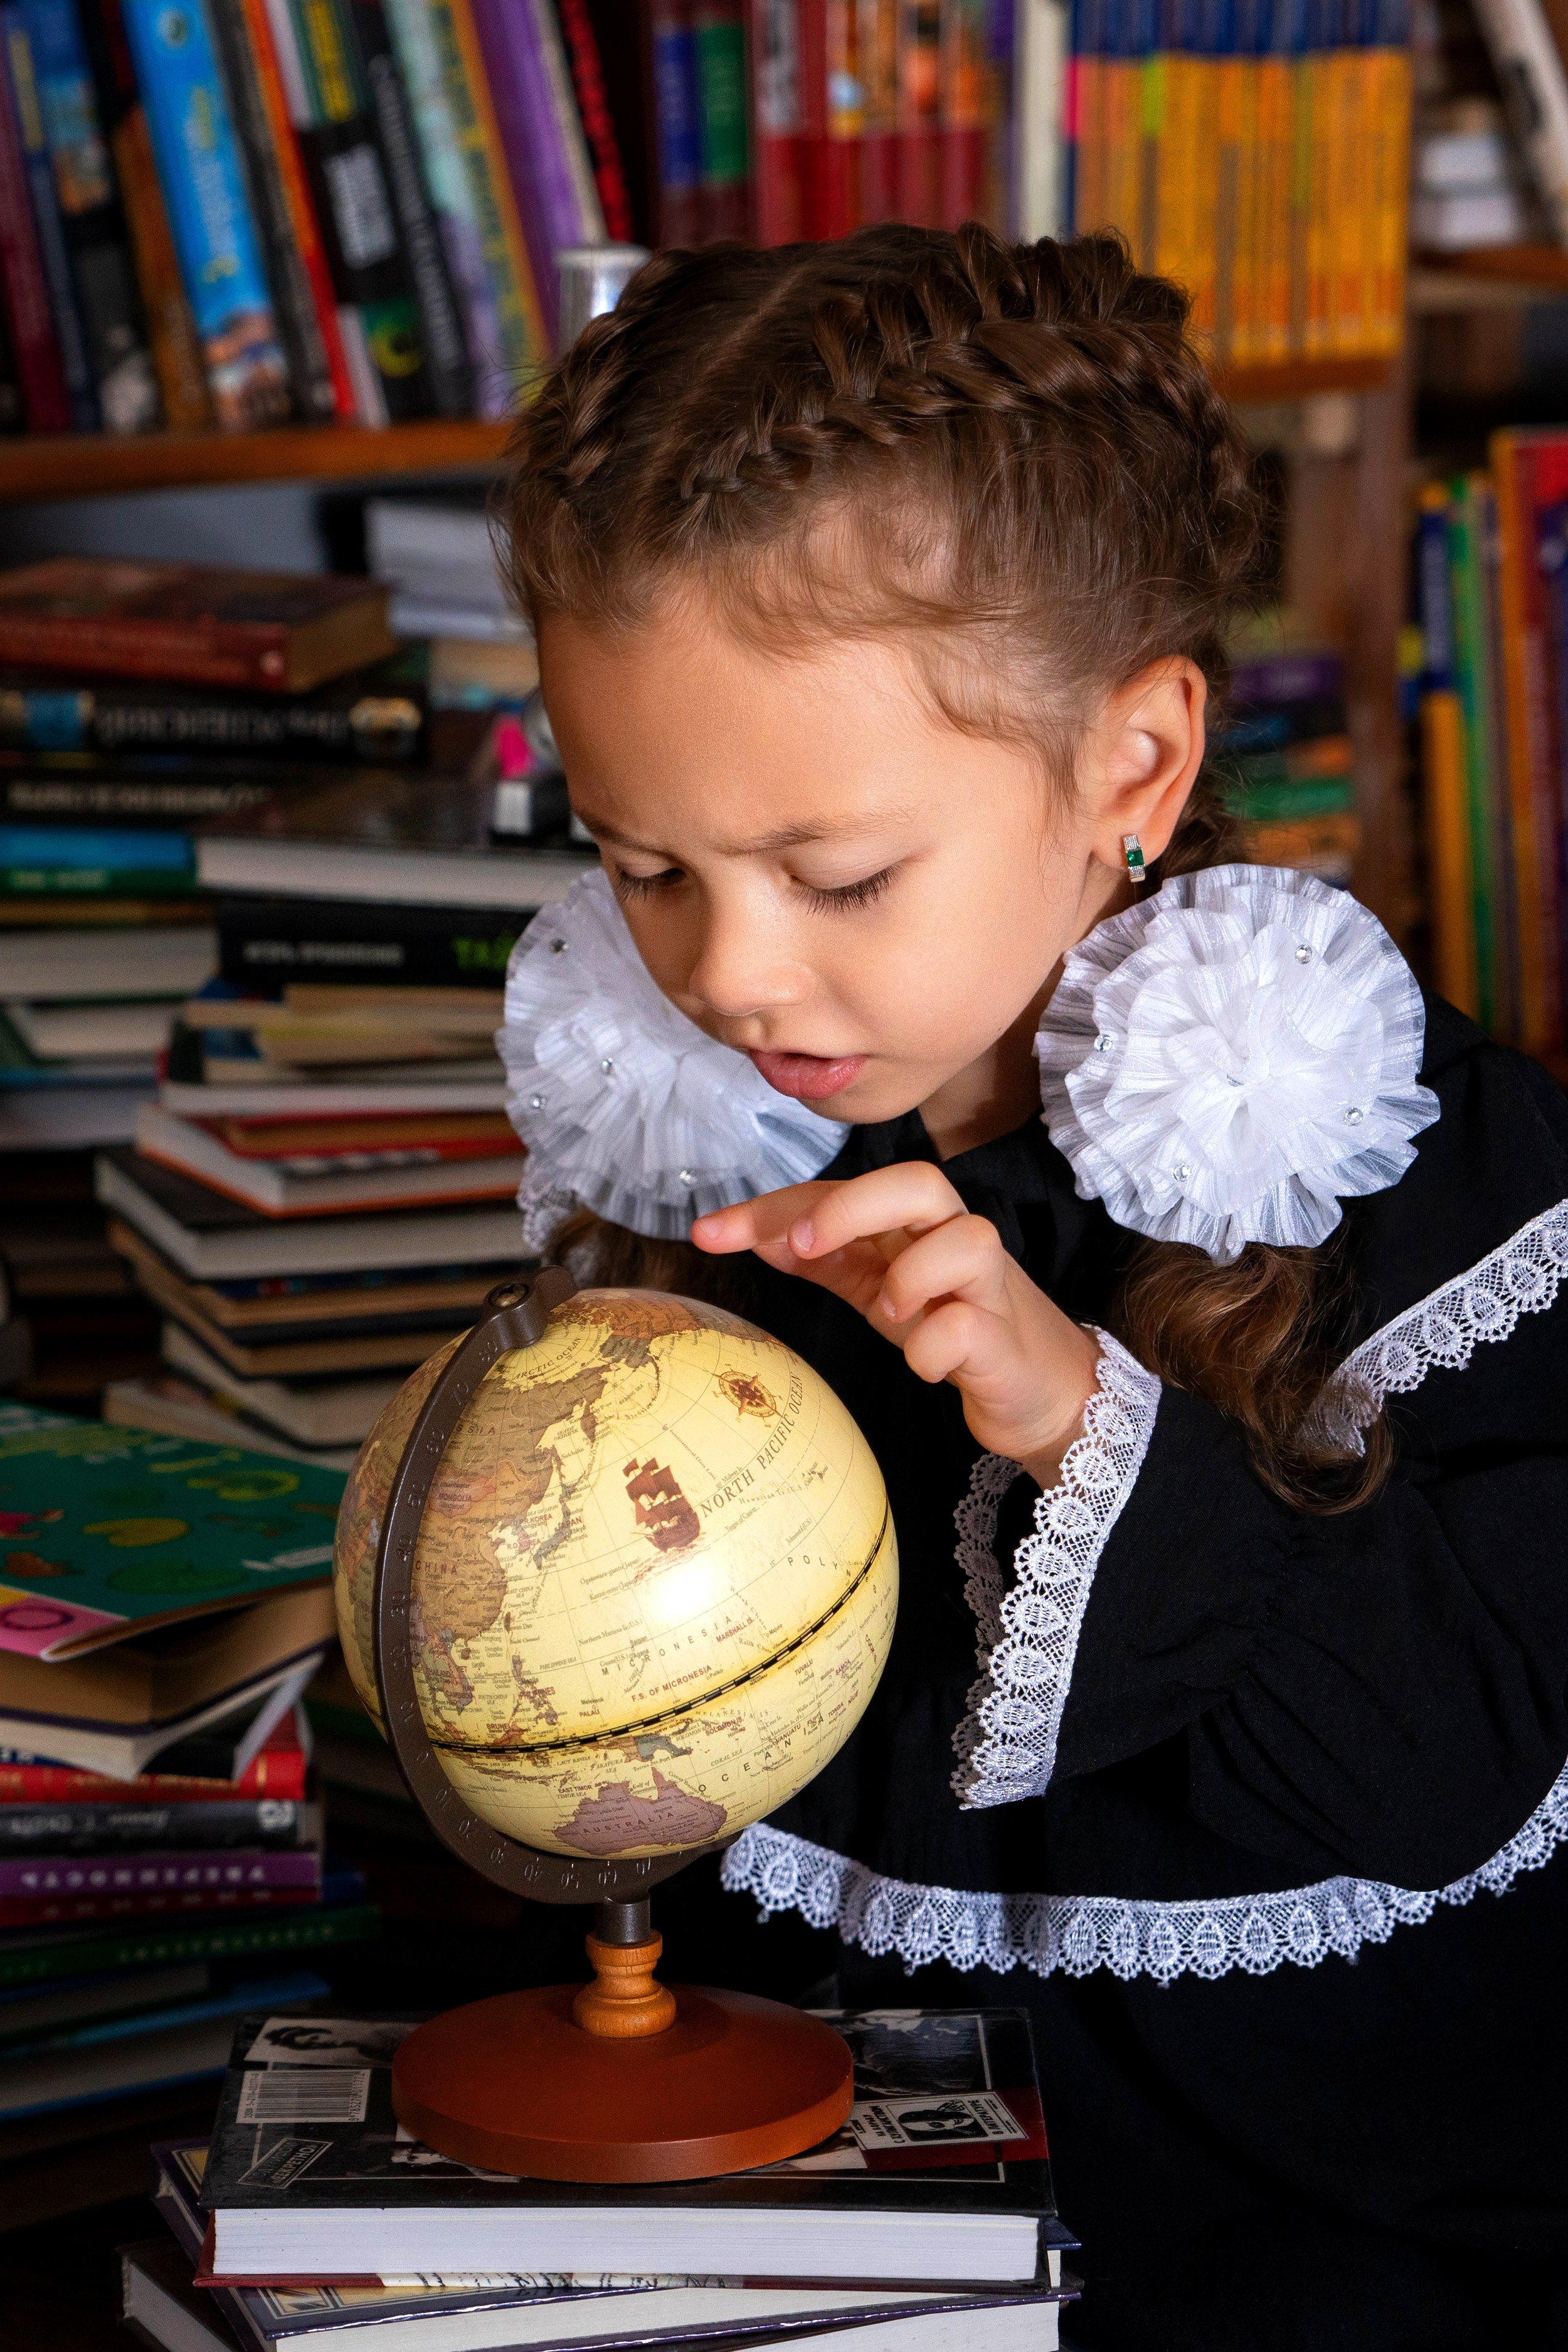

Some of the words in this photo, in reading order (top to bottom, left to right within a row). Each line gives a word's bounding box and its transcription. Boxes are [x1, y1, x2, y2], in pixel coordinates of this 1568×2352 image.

[514, 1360, 554, 1380] ARCTIC
[556, 1336, 581, 1361] OCEAN
[618, 1393, 635, 1405] BERING
[456, 1423, 496, 1435] SSIA
[699, 1468, 756, 1518] NORTH
[756, 1413, 795, 1471] PACIFIC
[788, 1371, 803, 1415] OCEAN
[438, 1493, 472, 1502] MONGOLIA
[558, 1516, 583, 1530] JAPAN
[415, 1560, 458, 1575] CHINA
[578, 1631, 601, 1646] Northern
[716, 1619, 748, 1642] MARSHALL
[601, 1615, 731, 1676] MICRONESIA
[539, 1659, 568, 1671] PHILIPPINE
[794, 1659, 814, 1676] TUVALU
[649, 1686, 660, 1696] OF
[662, 1664, 713, 1693] MICRONESIA
[579, 1710, 600, 1718] PALAU
[775, 1723, 802, 1744] VANUATU
[659, 1757, 670, 1765] Port
[711, 1755, 731, 1767] CORAL
[731, 1748, 743, 1759] SEA
[583, 1812, 674, 1835] AUSTRALIA
[968, 2099, 996, 2131] ЛИТЕРАТУРЕ
[272, 2144, 319, 2184] «СЕКРЕТНО»
